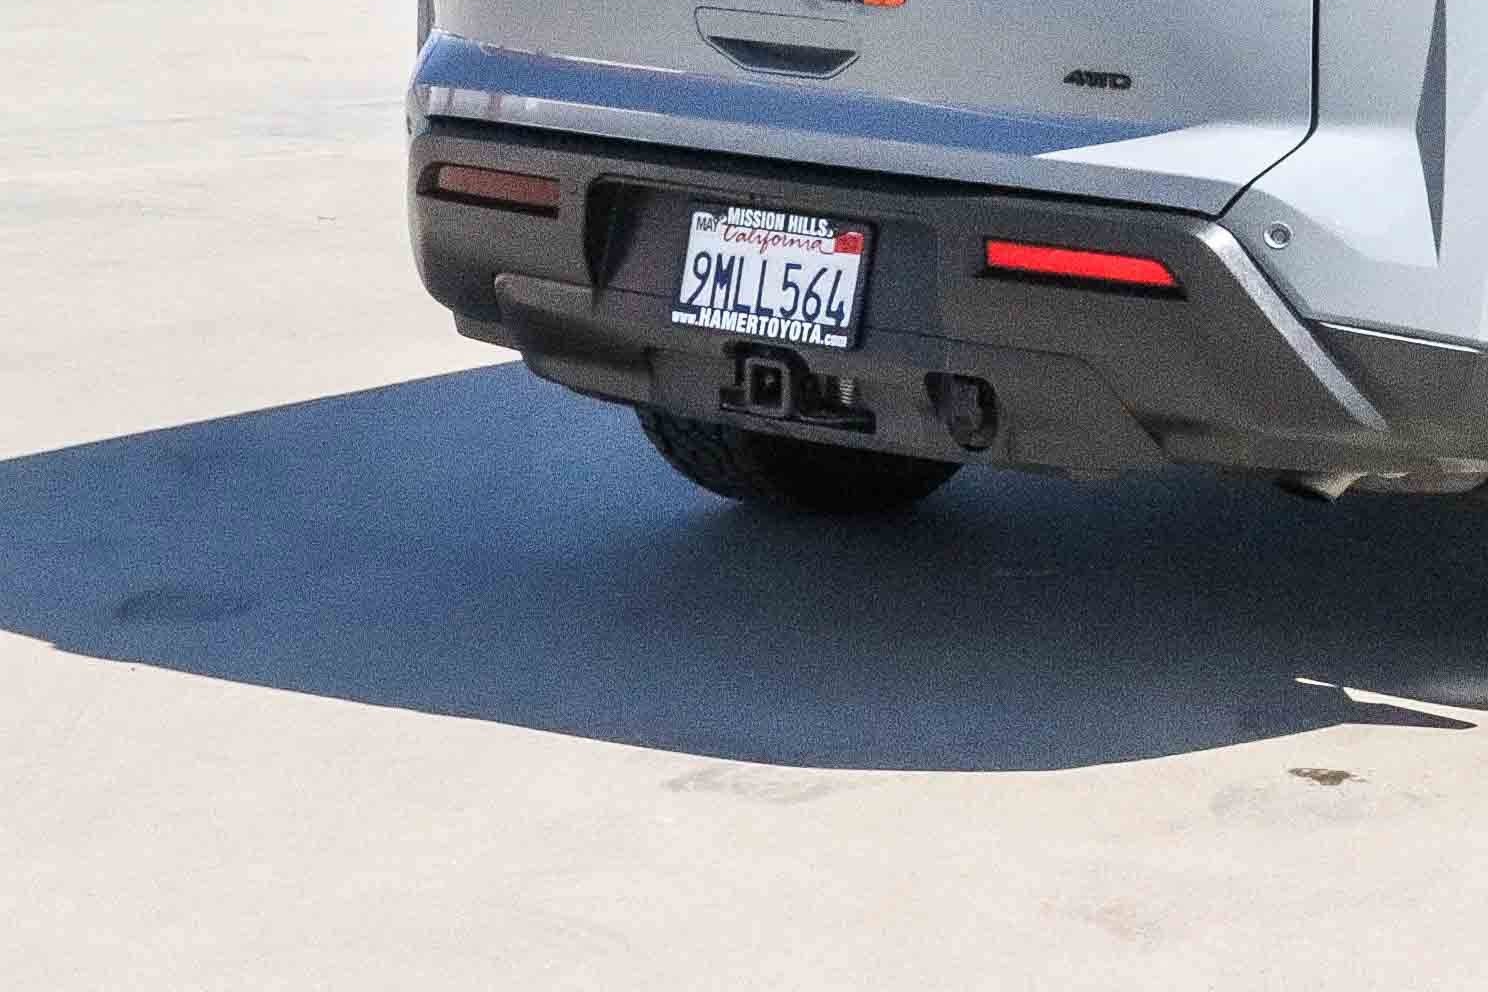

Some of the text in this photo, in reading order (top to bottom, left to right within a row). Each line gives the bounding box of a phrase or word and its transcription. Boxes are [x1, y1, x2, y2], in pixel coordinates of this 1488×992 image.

[1063, 69, 1132, 90] 4WD
[695, 215, 719, 232] MAY
[727, 207, 784, 231] MISSION
[723, 225, 833, 255] California
[687, 250, 845, 323] 9MLL564
[671, 306, 848, 348] www.HAMERTOYOTA.com
